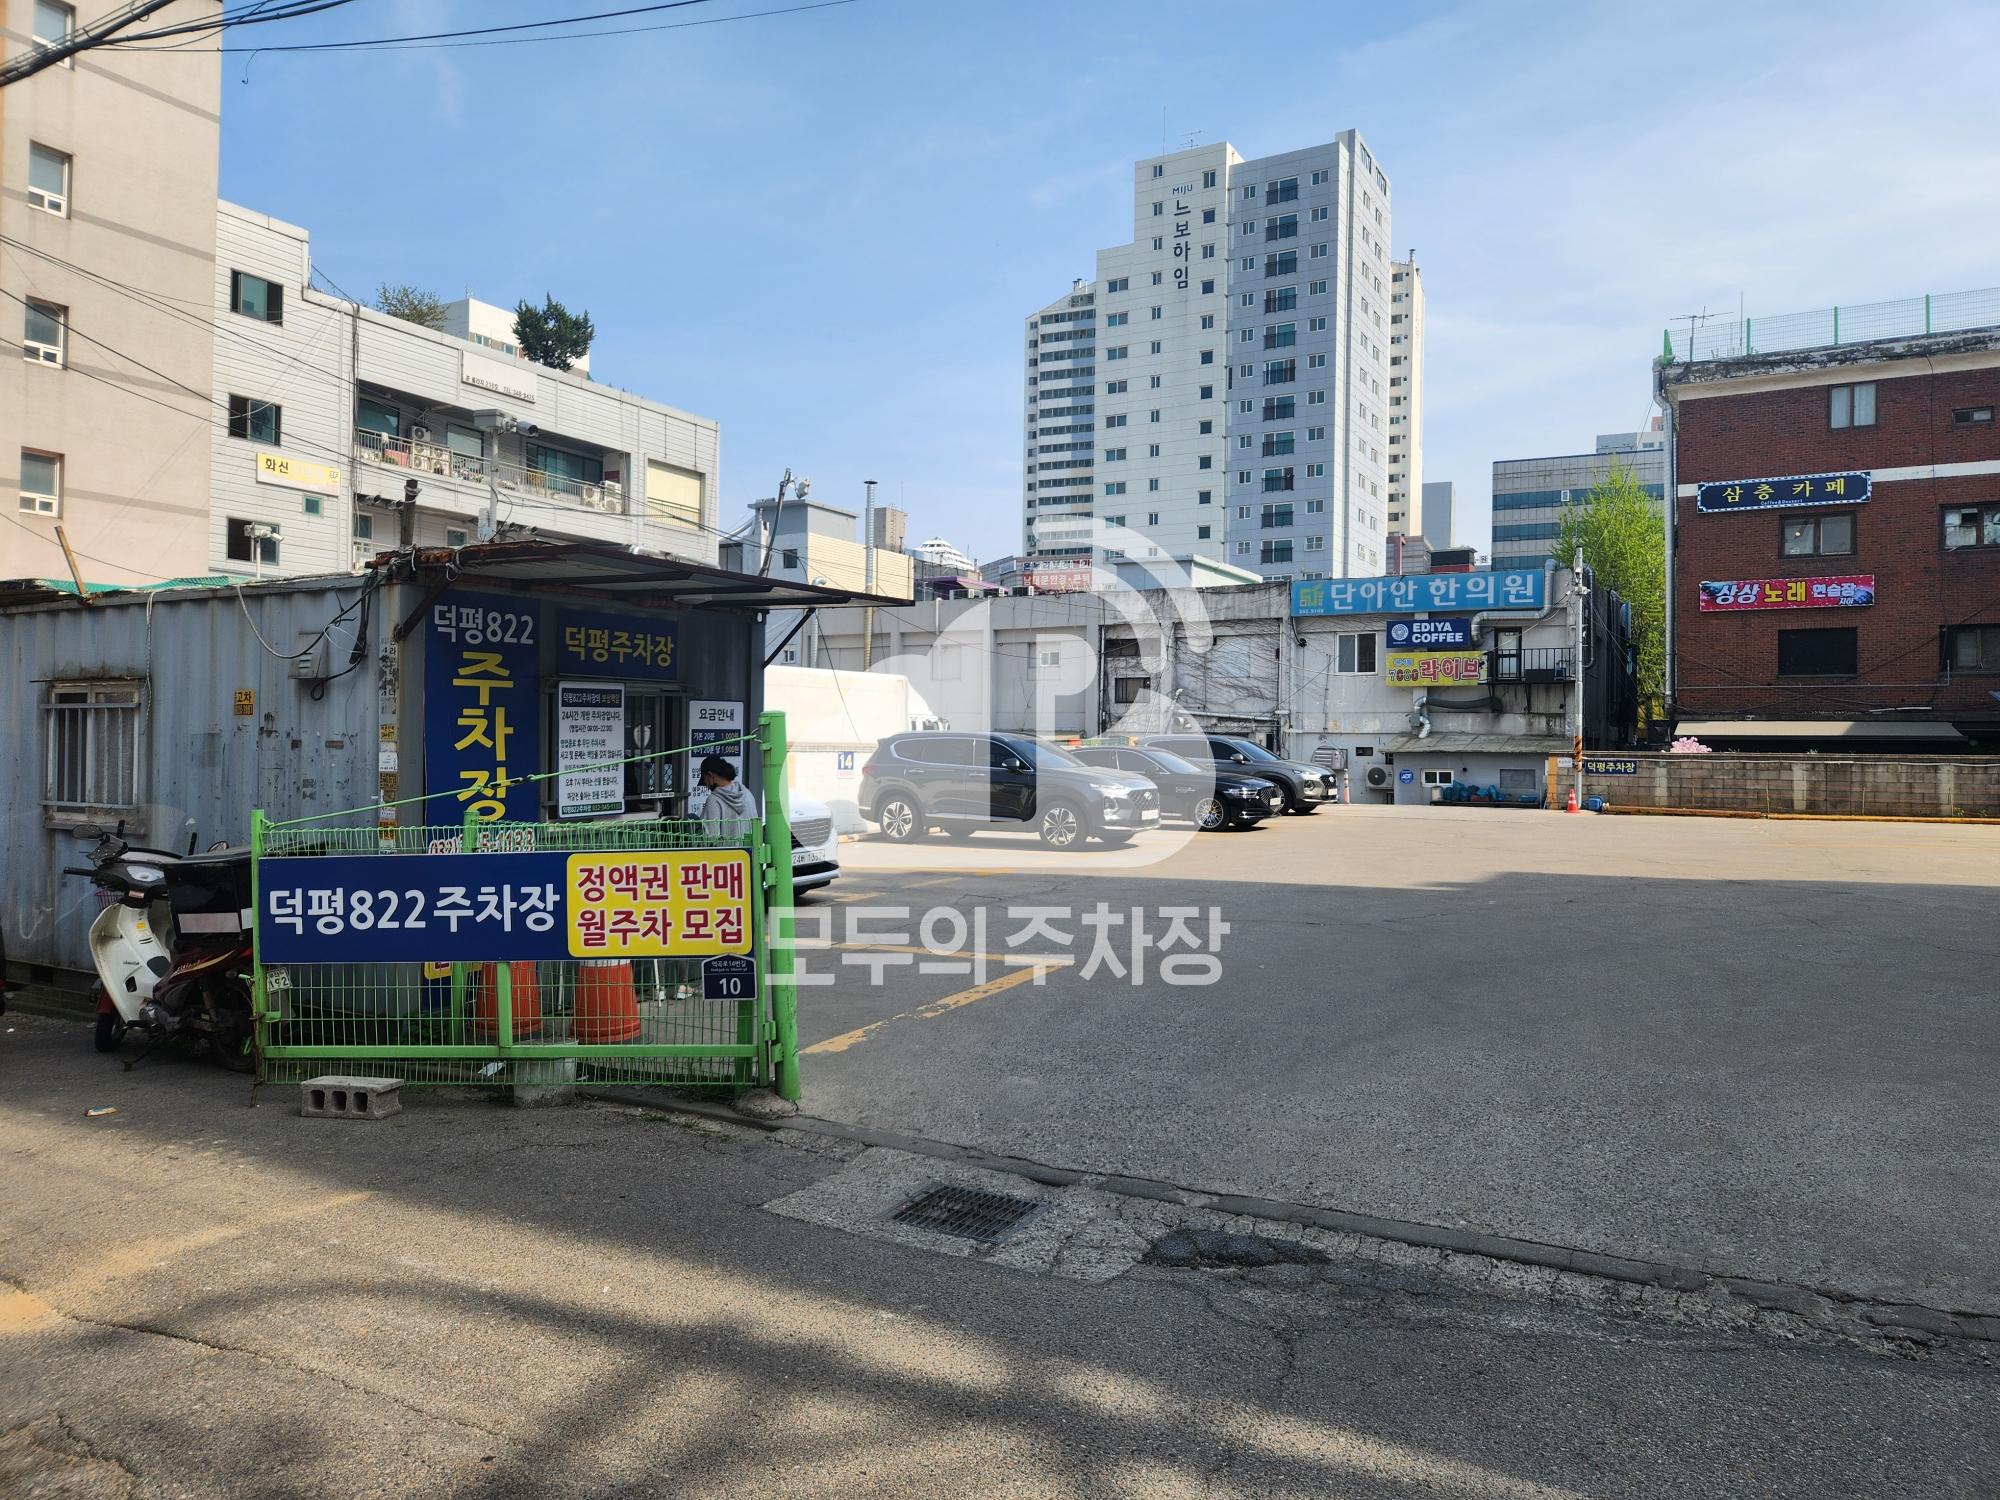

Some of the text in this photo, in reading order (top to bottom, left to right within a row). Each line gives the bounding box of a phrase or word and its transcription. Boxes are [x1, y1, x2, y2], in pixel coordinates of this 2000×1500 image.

[1172, 184, 1193, 195] MIJU
[1173, 199, 1191, 289] 느보하임
[1330, 574, 1534, 610] 단아안 한의원
[1715, 583, 1760, 604] 상상
[1764, 581, 1806, 602] 노래
[434, 604, 534, 645] 덕평822
[1412, 622, 1453, 632] EDIYA
[565, 626, 674, 668] 덕평주차장
[1411, 632, 1464, 643] COFFEE
[698, 708, 735, 721] 요금안내
[453, 651, 514, 822] 주차장
[839, 754, 852, 769] 14
[1587, 761, 1636, 773] 덕평주차장
[577, 862, 743, 902] 정액권 판매
[577, 907, 743, 947] 월주차 모집
[719, 977, 741, 995] 10
